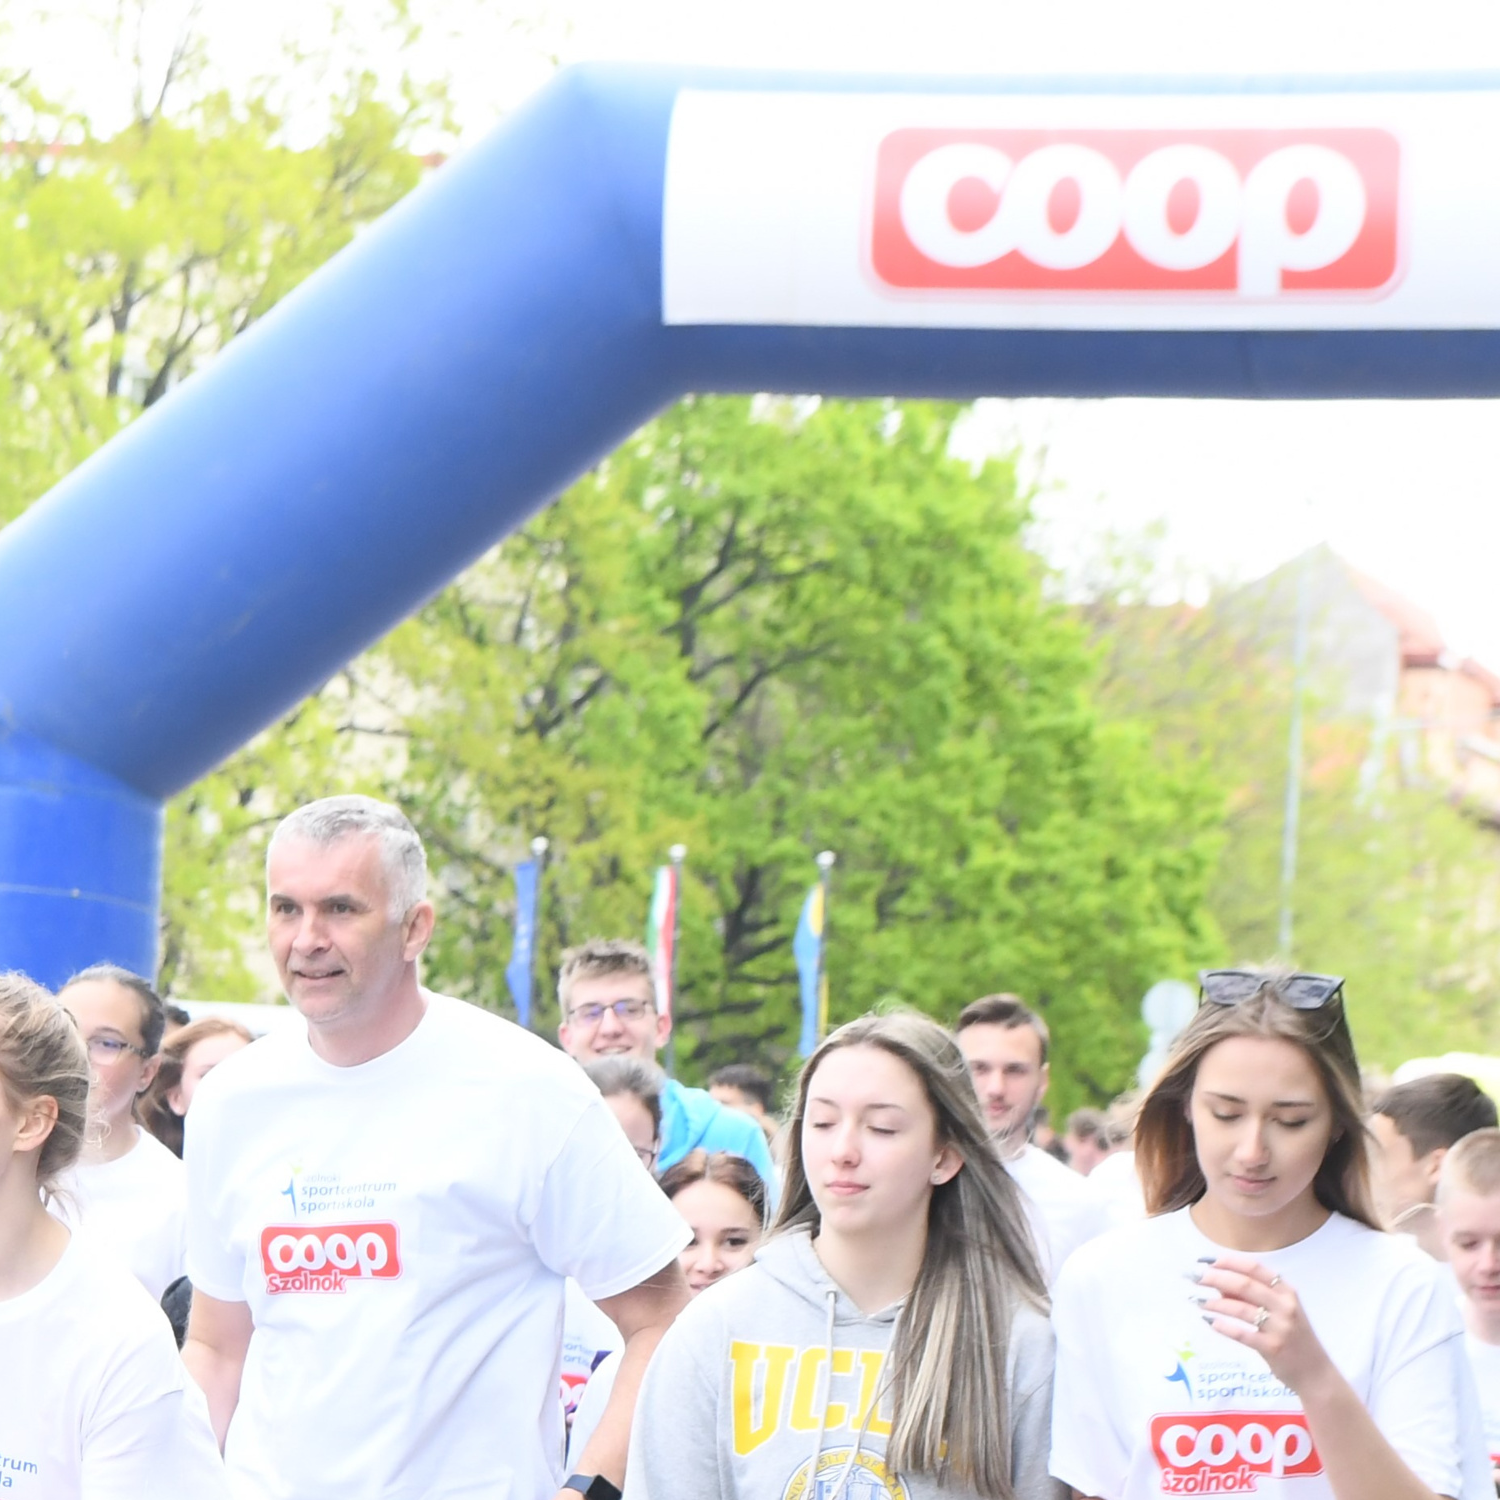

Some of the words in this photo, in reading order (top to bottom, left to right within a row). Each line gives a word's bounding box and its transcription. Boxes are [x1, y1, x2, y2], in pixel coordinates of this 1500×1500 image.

[900, 142, 1368, 298] coop
[301, 1181, 397, 1199] sportcentrum
[300, 1196, 375, 1214] sportiskola
[268, 1232, 388, 1278] coop
[267, 1270, 345, 1293] Szolnok
[1198, 1371, 1274, 1385] sportce
[729, 1340, 948, 1462] UCL
[861, 1454, 881, 1468] OF
[1160, 1422, 1313, 1479] coop
[1161, 1465, 1256, 1493] Szolnok
